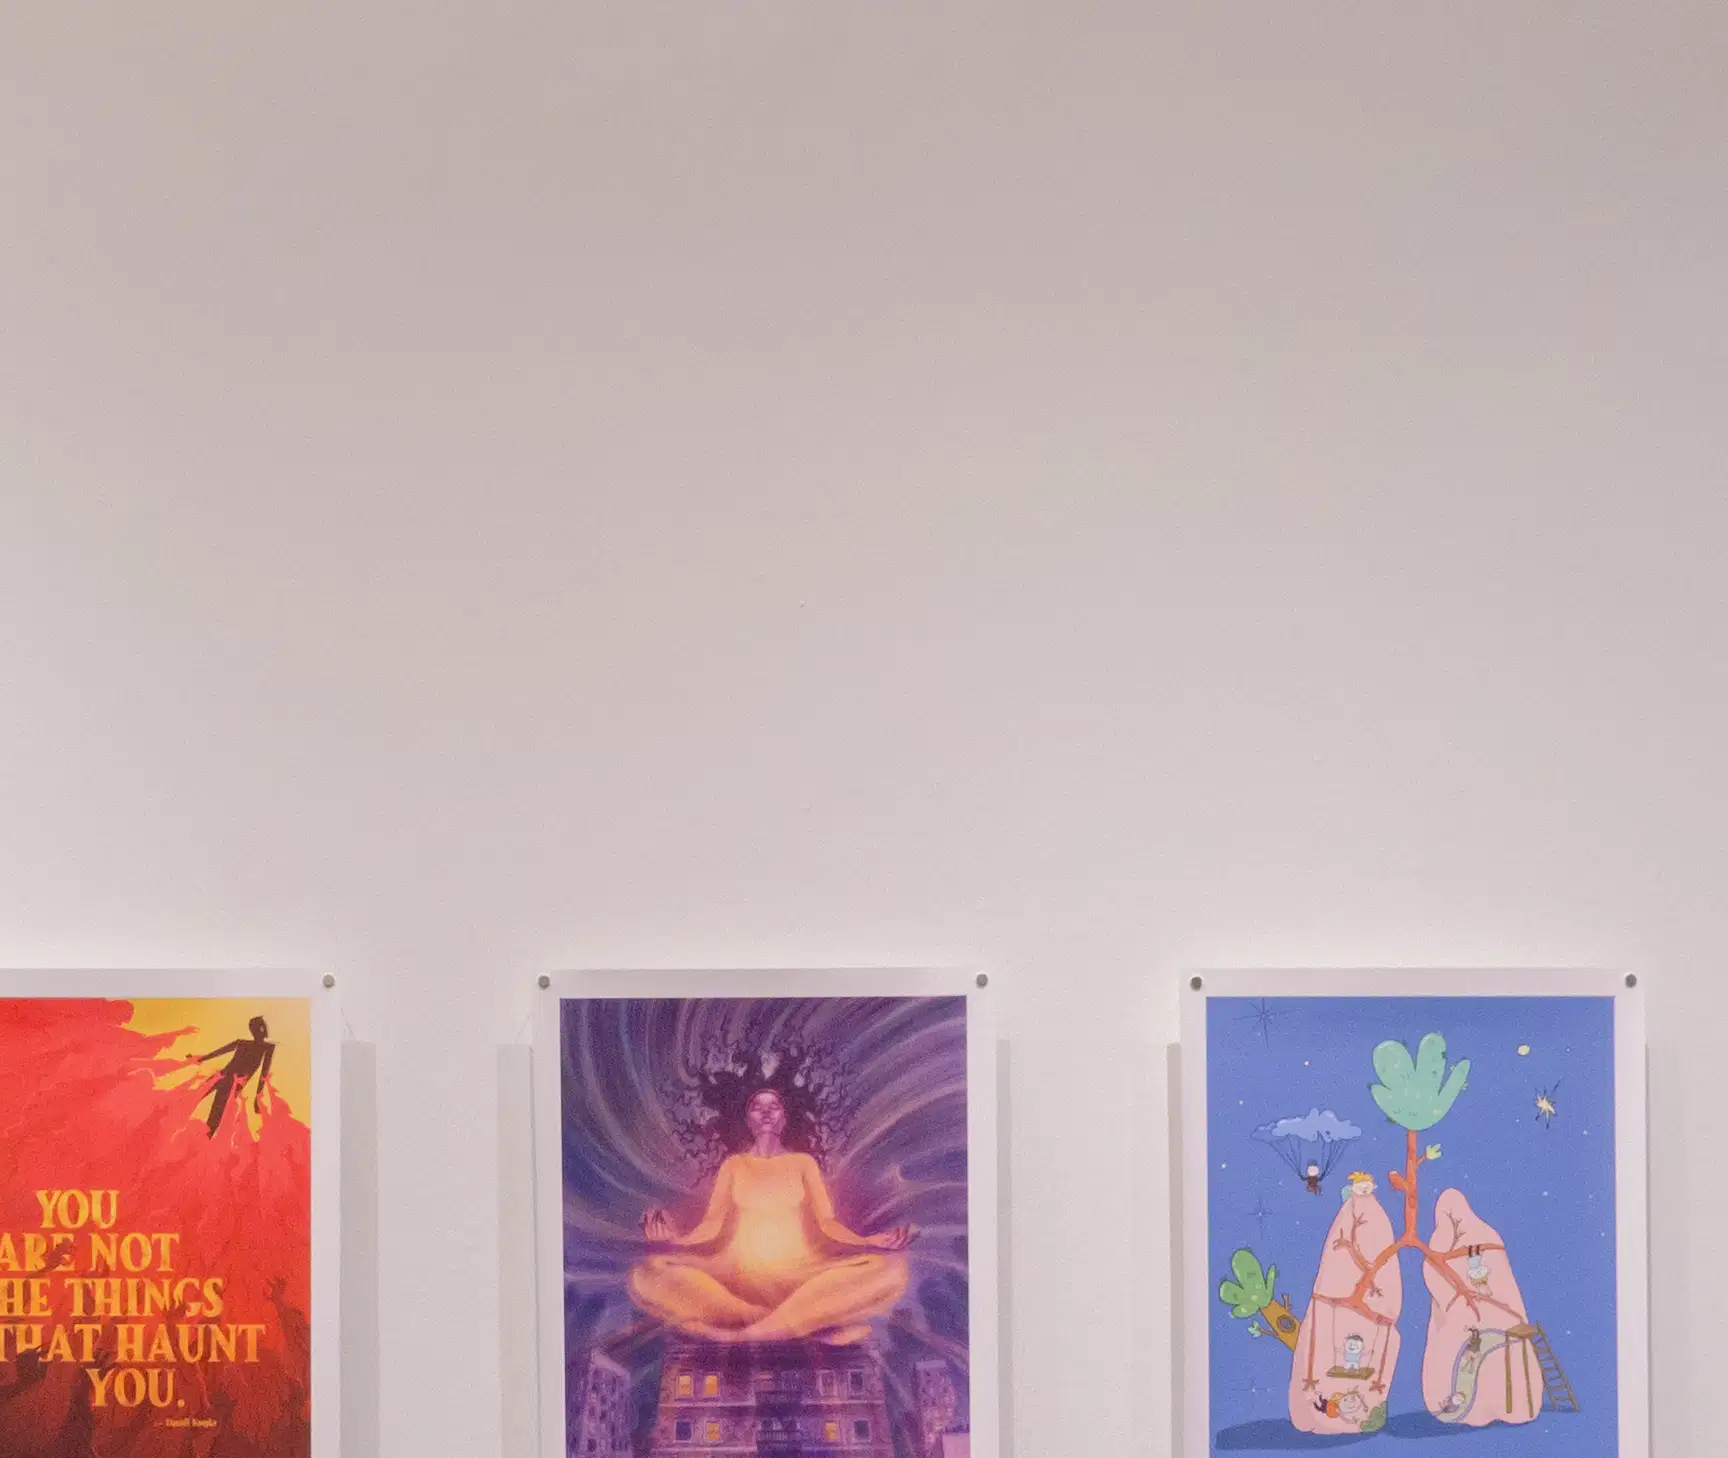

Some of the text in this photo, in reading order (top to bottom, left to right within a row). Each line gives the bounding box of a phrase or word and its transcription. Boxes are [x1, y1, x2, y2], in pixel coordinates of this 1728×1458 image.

[36, 1189, 119, 1229] YOU
[89, 1232, 180, 1273] NOT
[64, 1276, 224, 1318] THINGS
[115, 1323, 267, 1363] HAUNT
[86, 1367, 185, 1408] YOU.
